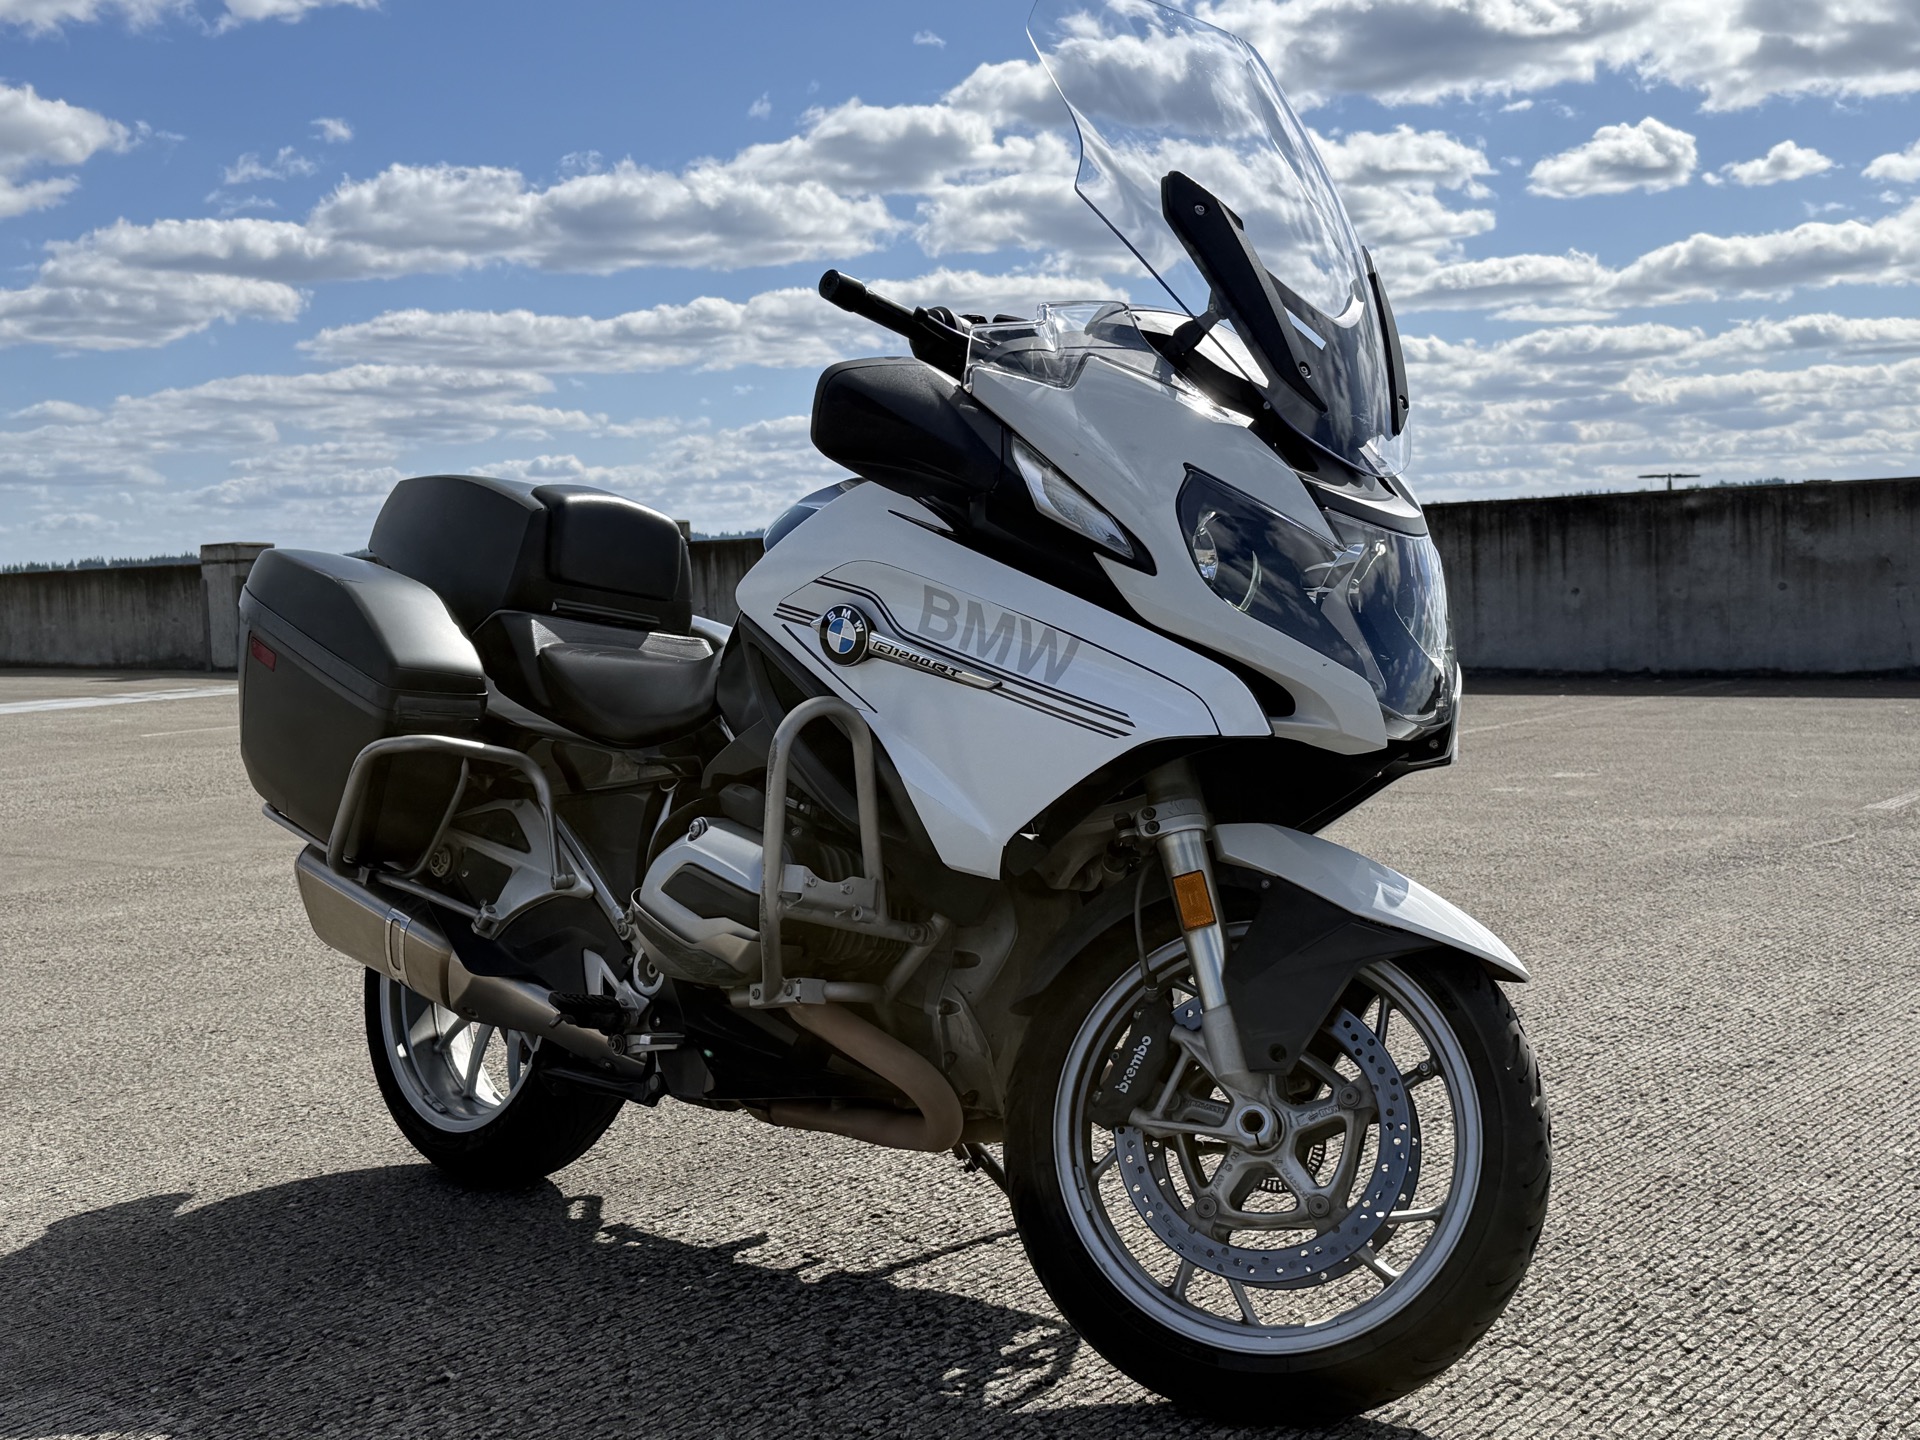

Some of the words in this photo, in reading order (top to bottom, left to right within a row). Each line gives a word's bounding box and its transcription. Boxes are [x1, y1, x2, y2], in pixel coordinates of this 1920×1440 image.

[827, 608, 864, 633] BMW
[918, 584, 1080, 684] BMW
[1115, 1035, 1152, 1094] brembo
